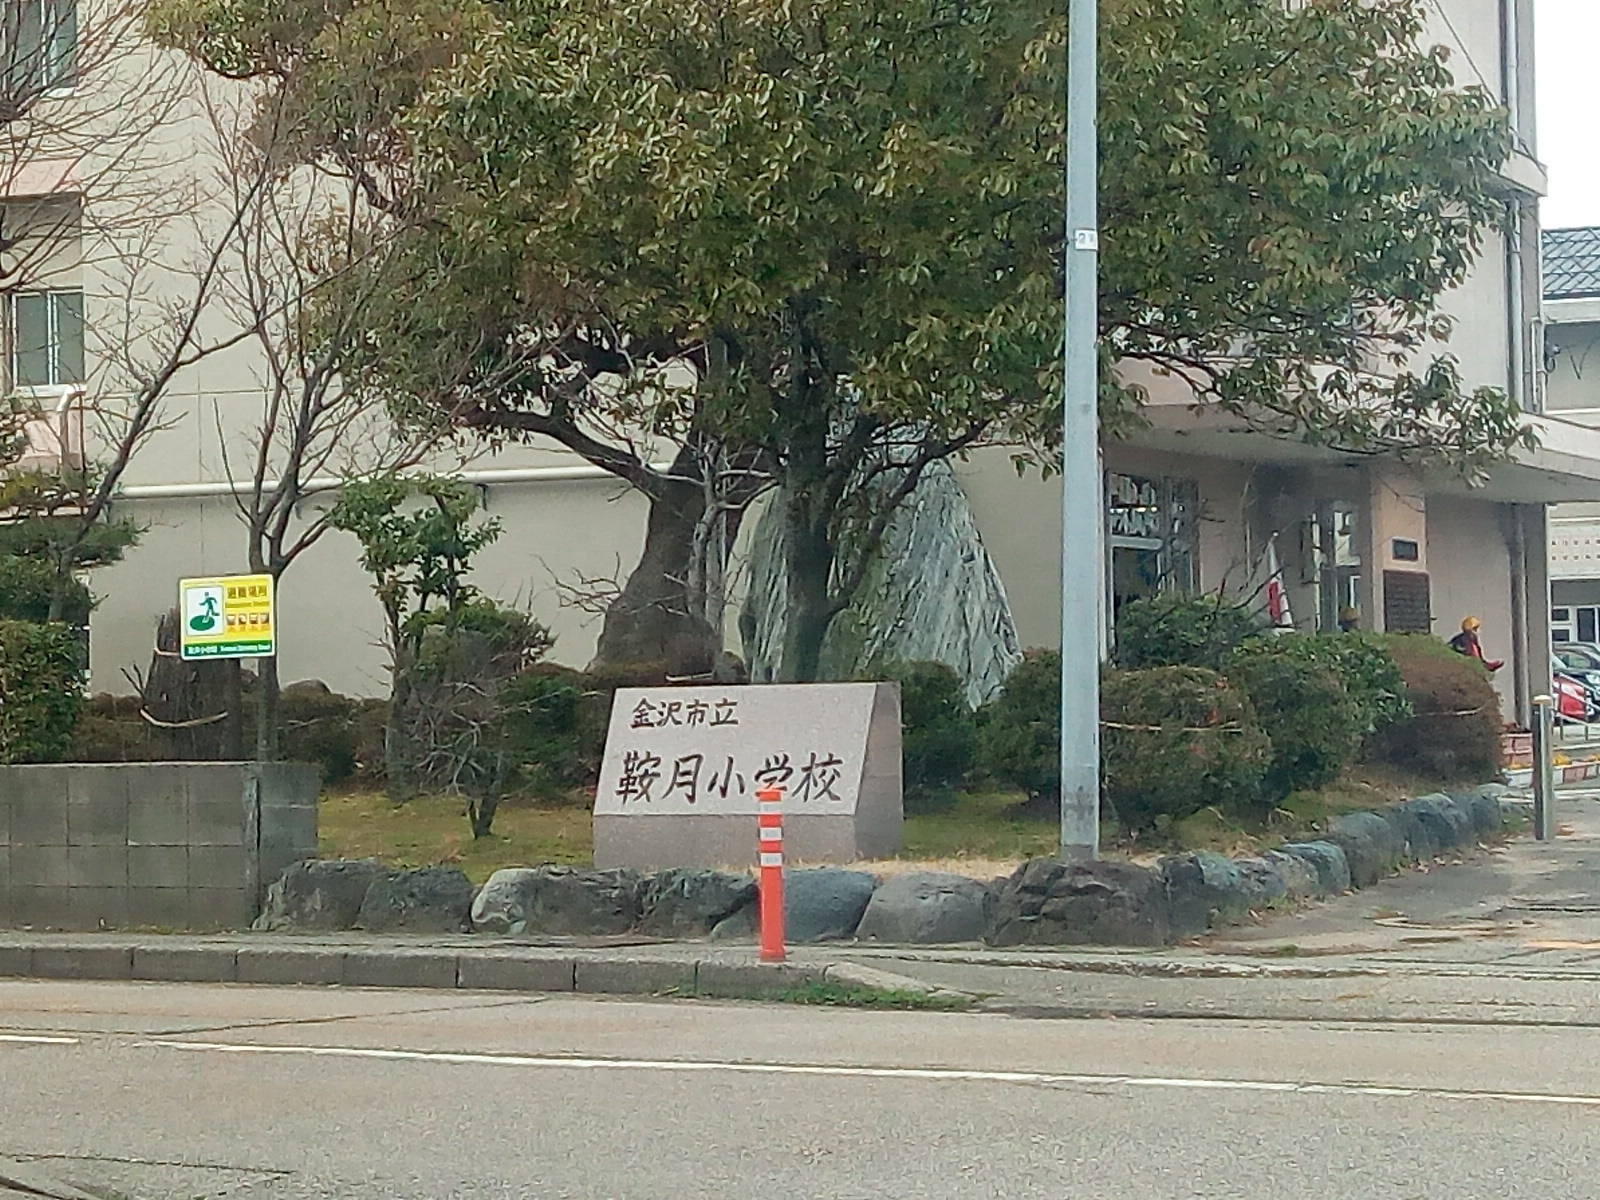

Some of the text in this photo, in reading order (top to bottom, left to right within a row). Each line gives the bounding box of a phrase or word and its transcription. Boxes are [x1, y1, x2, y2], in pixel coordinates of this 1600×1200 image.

[630, 697, 740, 729] 金沢市立
[615, 751, 844, 805] 鞍月小学校
